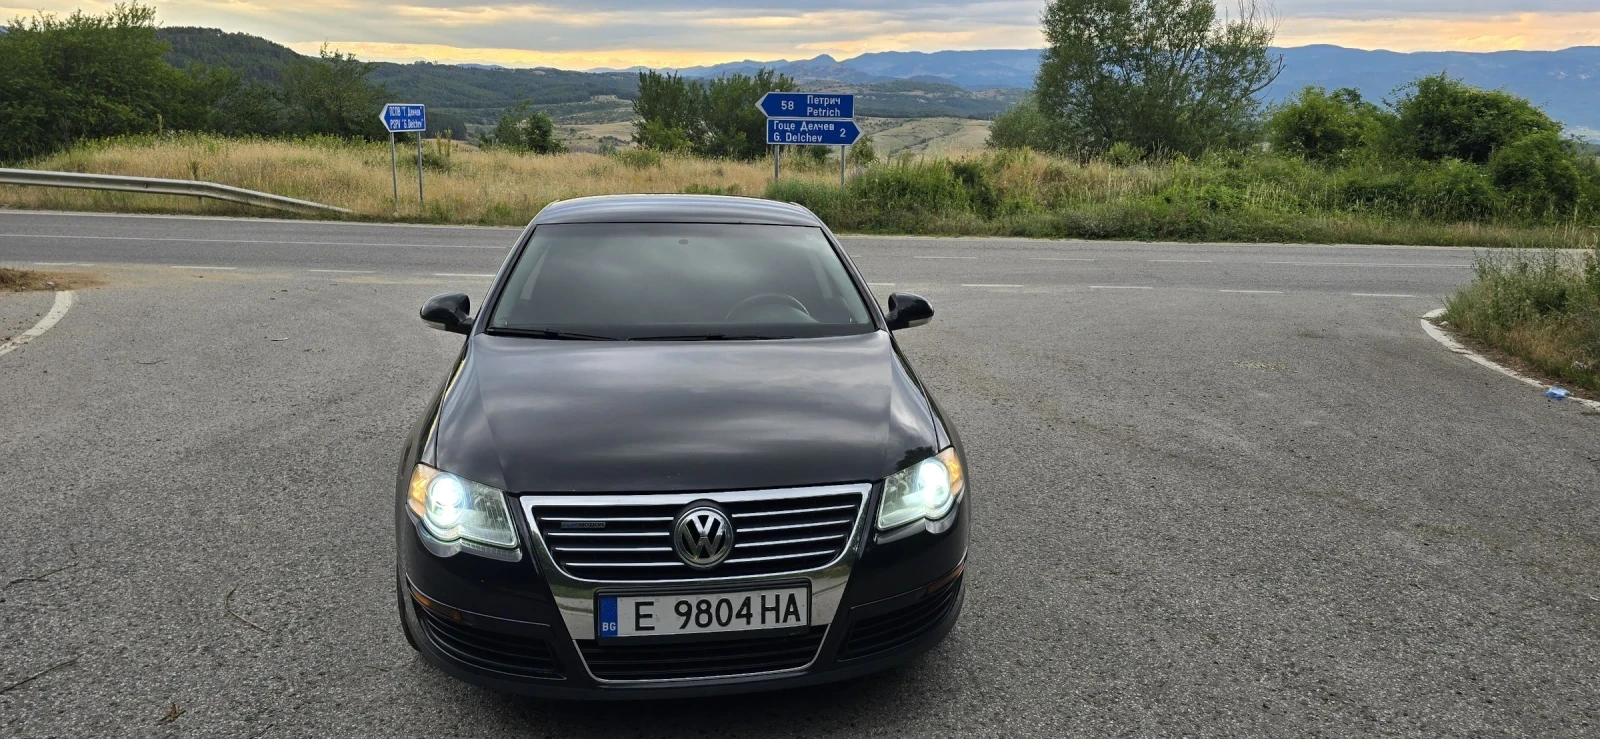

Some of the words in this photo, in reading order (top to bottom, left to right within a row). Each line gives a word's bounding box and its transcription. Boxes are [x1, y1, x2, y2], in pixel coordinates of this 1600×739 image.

[781, 100, 795, 110] 58
[806, 94, 841, 107] Петрич
[806, 106, 841, 117] Petrich
[773, 120, 796, 131] Гоце
[800, 121, 835, 132] Делчев
[773, 132, 781, 142] G.
[785, 132, 823, 142] Delchev
[839, 128, 846, 138] 2
[679, 509, 728, 564] VW
[634, 601, 655, 632] E
[602, 622, 617, 632] BG
